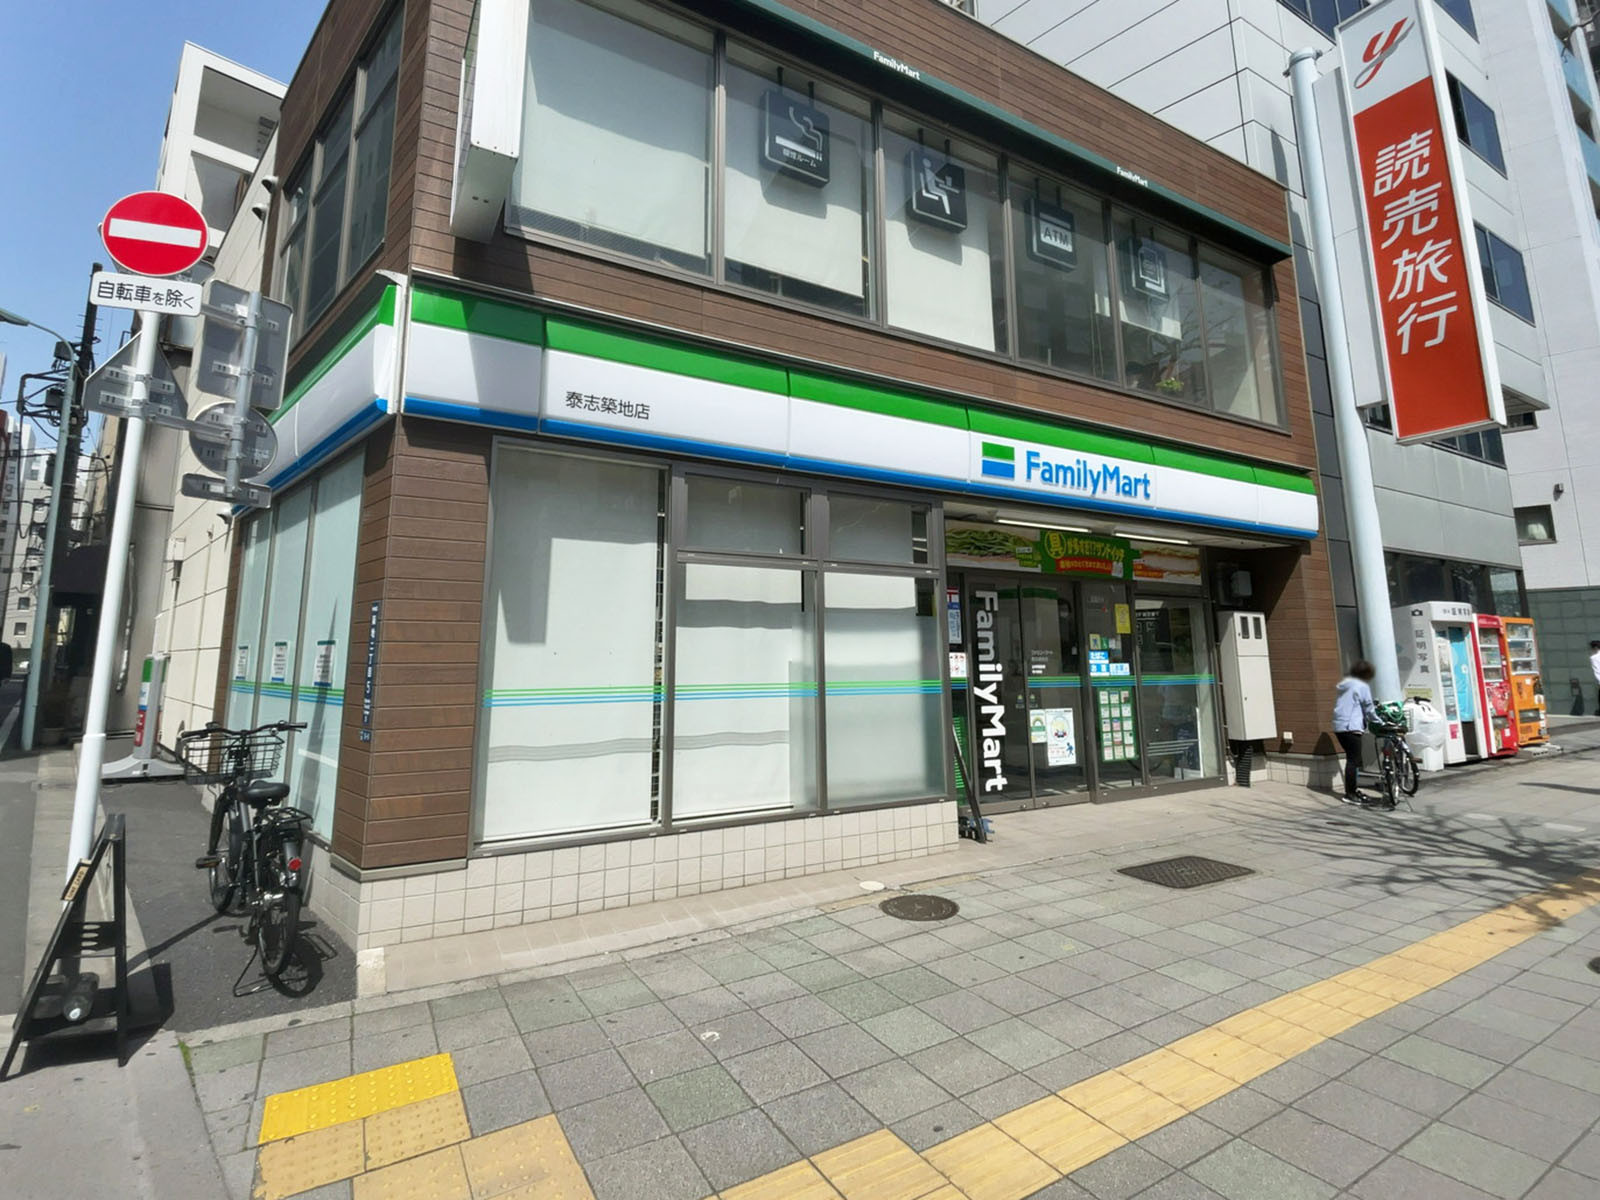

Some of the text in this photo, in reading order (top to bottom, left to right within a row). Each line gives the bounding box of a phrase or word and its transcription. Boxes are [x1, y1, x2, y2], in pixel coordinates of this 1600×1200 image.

[873, 50, 920, 80] FamilyMart
[1116, 166, 1148, 188] FamilyMart
[1043, 227, 1069, 246] ATM
[1373, 129, 1459, 355] 読売旅行
[97, 280, 195, 309] 自転車を除く
[565, 391, 650, 420] 泰志築地店
[1026, 450, 1151, 500] FamilyMart
[1415, 629, 1431, 674] 証明写真
[973, 590, 1008, 792] FamilyMart
